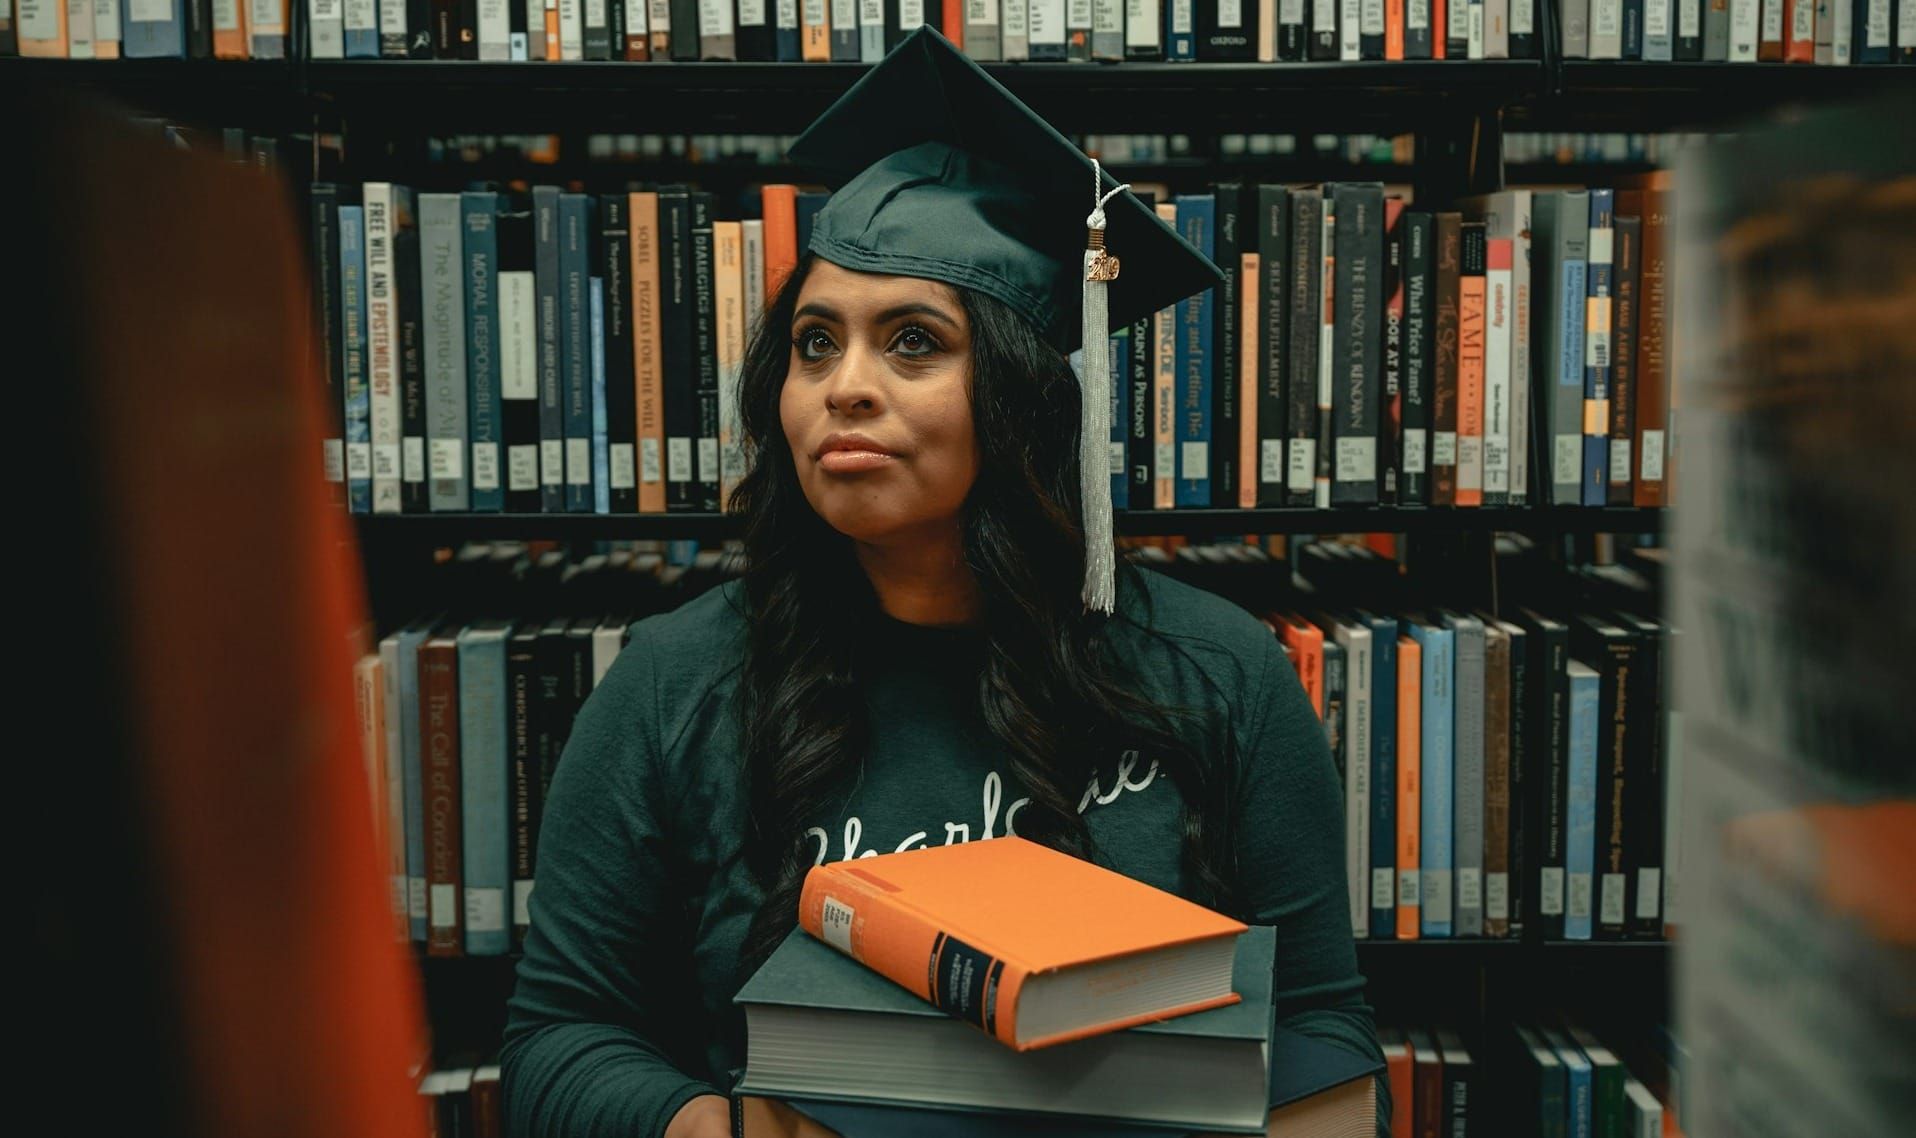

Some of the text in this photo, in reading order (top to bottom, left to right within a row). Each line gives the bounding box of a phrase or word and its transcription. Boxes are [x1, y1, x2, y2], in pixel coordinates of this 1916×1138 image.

[638, 225, 651, 264] SOBEL
[369, 202, 390, 397] FREE WILL AND EPISTEMOLOGY
[694, 236, 710, 314] DIALECTICS
[431, 241, 456, 405] The Magnitude of
[1268, 261, 1281, 399] SELF-FULFILLMENT
[1387, 307, 1400, 345] LOOK
[1461, 290, 1484, 369] FAME
[1493, 283, 1506, 328] celebrity
[1516, 284, 1528, 343] CELEBRITY
[474, 253, 491, 442] MORAL RESPONSIBILITY
[544, 344, 555, 367] AND
[638, 280, 656, 432] PUZZLES FOR THE WILL
[1184, 292, 1205, 437] lling and Letting Die
[1225, 332, 1233, 354] AND
[1350, 256, 1367, 429] THE FRENZY OF RENOWN
[1387, 349, 1399, 370] AT
[1407, 274, 1424, 405] What Price Fame?
[1594, 344, 1607, 367] gift
[701, 355, 713, 386] WILL
[1224, 357, 1233, 401] LETTING
[1613, 666, 1629, 721] Speaking
[1356, 699, 1367, 764] EMBODIED
[430, 692, 455, 884] The Call of Conscienc
[1356, 765, 1366, 794] CARE
[1452, 1117, 1467, 1138] FREN
